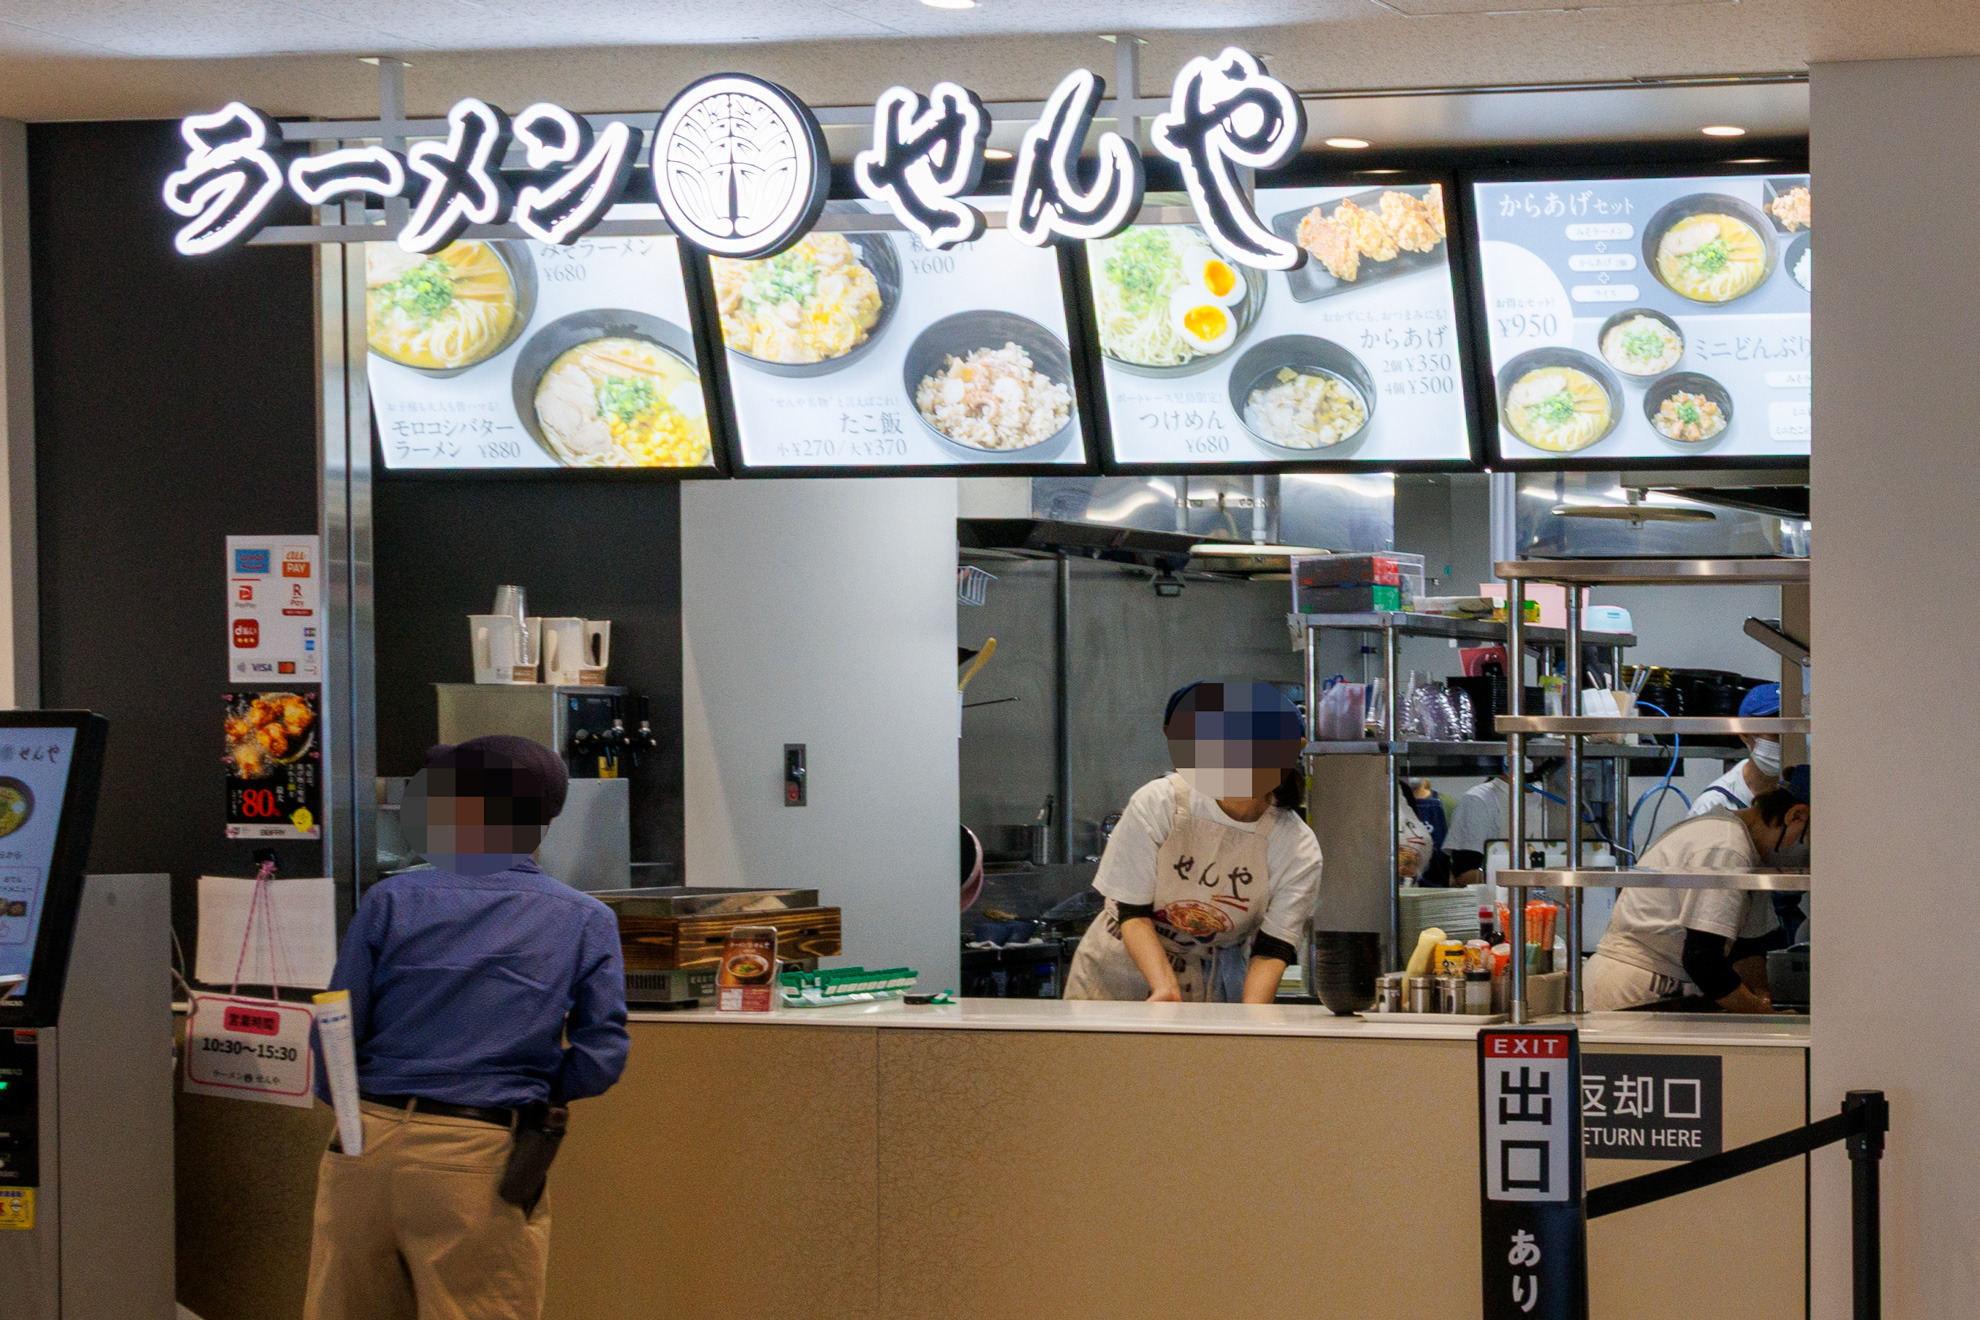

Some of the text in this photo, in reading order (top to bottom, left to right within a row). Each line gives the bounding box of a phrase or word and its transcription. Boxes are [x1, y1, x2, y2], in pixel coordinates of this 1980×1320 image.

[163, 46, 1300, 269] ラーメン せんや
[1498, 190, 1634, 218] からあげセット
[543, 263, 587, 282] ¥680
[911, 255, 955, 275] ¥600
[1497, 313, 1558, 338] ¥950
[1360, 325, 1449, 350] からあげ
[391, 418, 515, 437] モロコシバター
[839, 412, 904, 435] たこ飯
[1138, 410, 1226, 431] つけめん
[396, 441, 521, 460] ラーメン ¥880
[1184, 435, 1230, 454] ¥680
[1173, 854, 1253, 903] せんや
[1493, 1038, 1560, 1054] EXIT
[1498, 1066, 1552, 1193] 出口
[1583, 1127, 1702, 1148] ETURN HERE
[1507, 1229, 1541, 1313] あり
